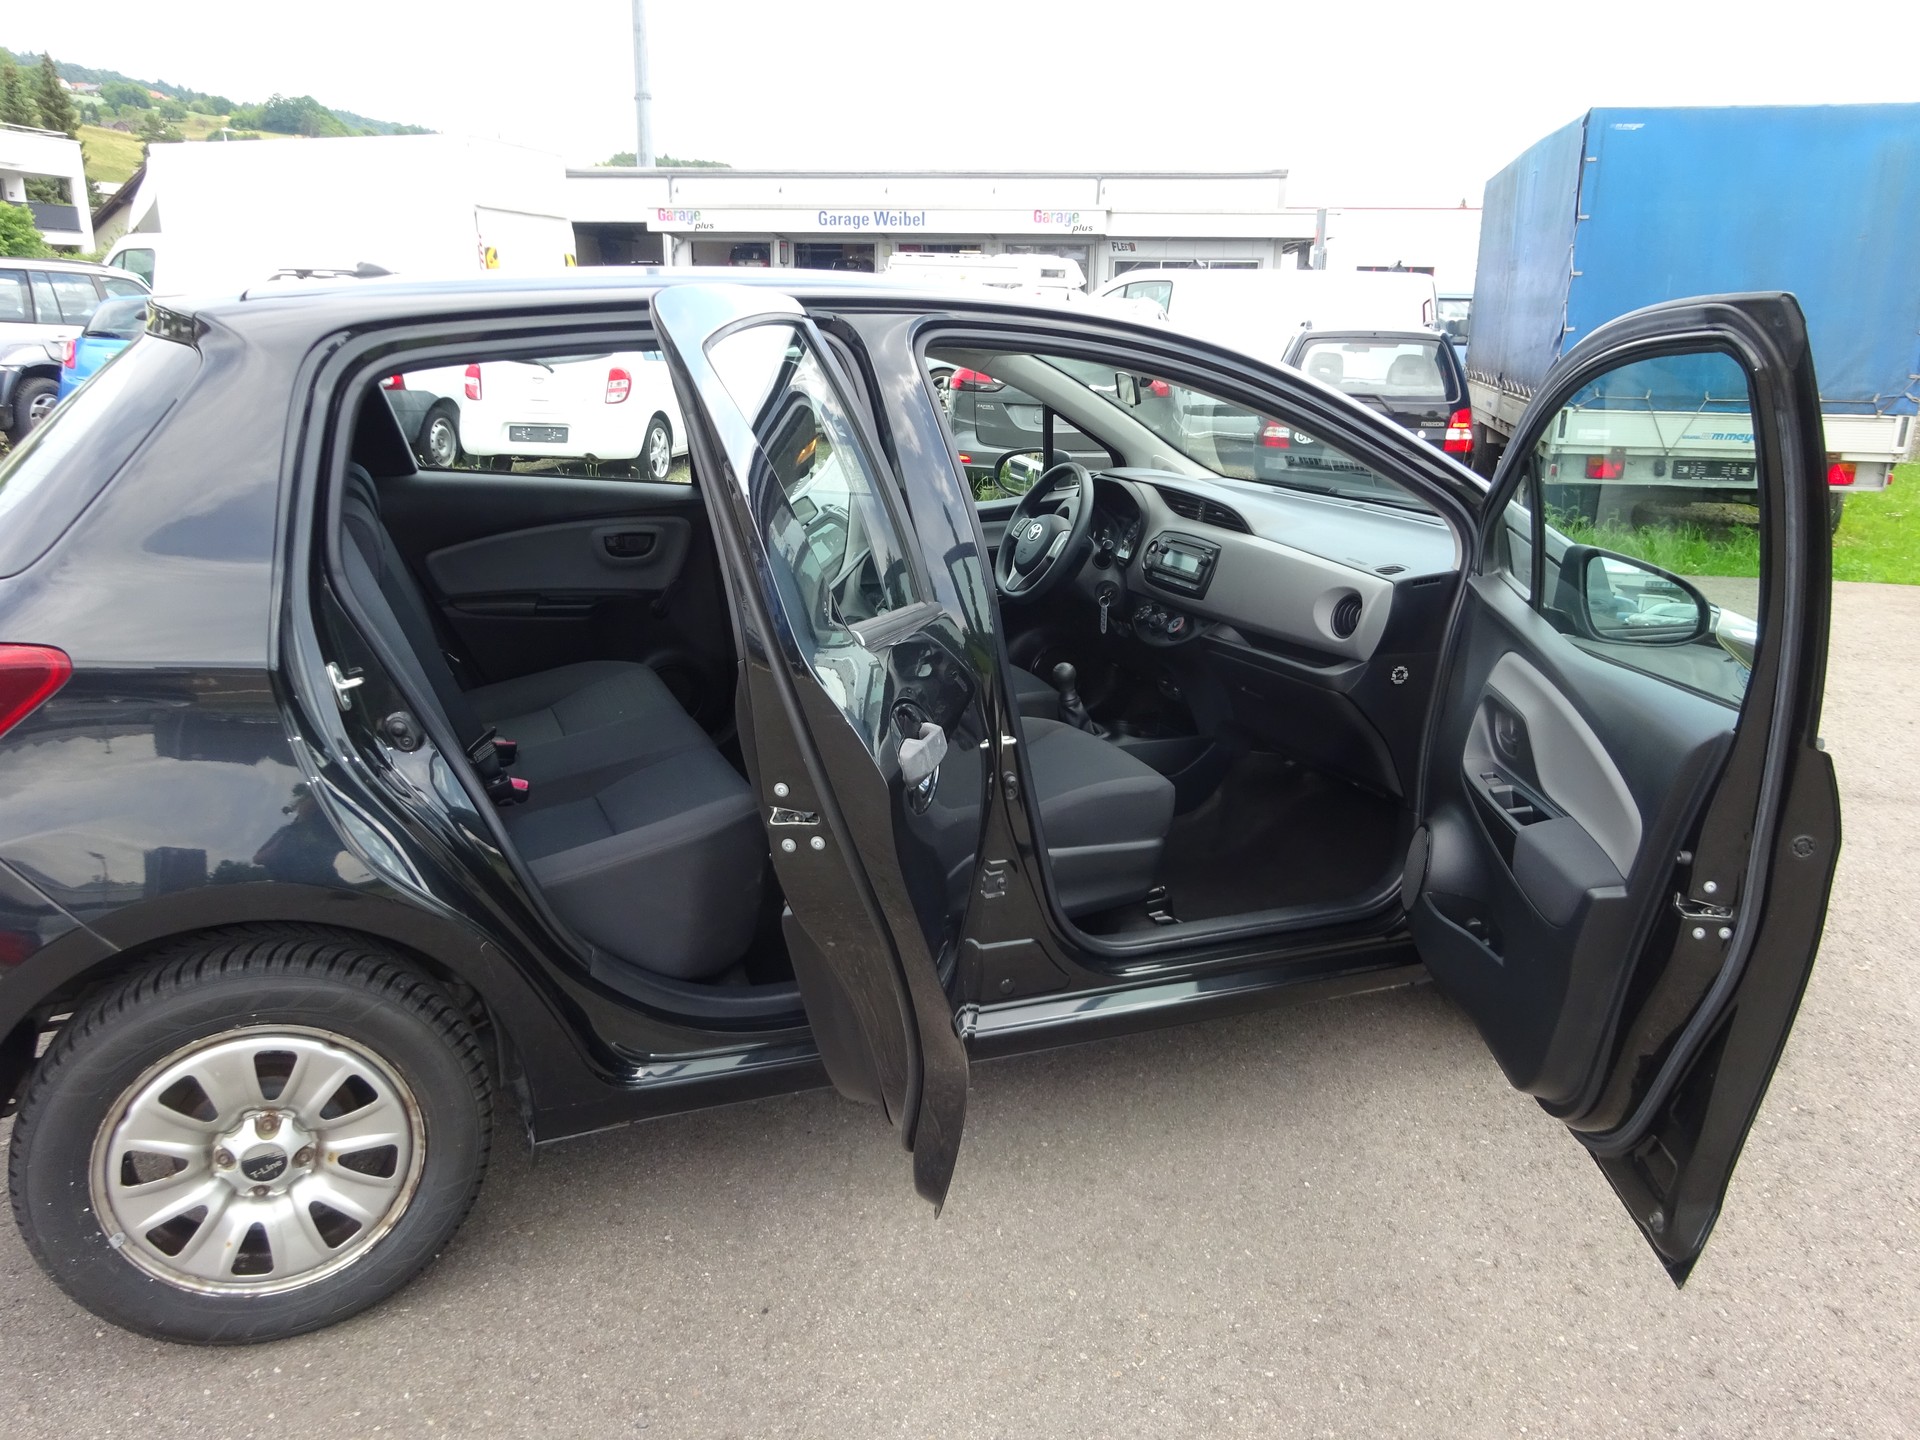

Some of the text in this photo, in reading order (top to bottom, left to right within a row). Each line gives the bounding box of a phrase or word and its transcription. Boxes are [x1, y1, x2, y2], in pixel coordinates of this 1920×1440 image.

[657, 207, 701, 225] Garage
[818, 210, 925, 230] Garage Weibel
[1033, 209, 1080, 227] Garage
[694, 222, 715, 232] plus
[1072, 224, 1093, 234] plus
[249, 1160, 283, 1179] T-Line
